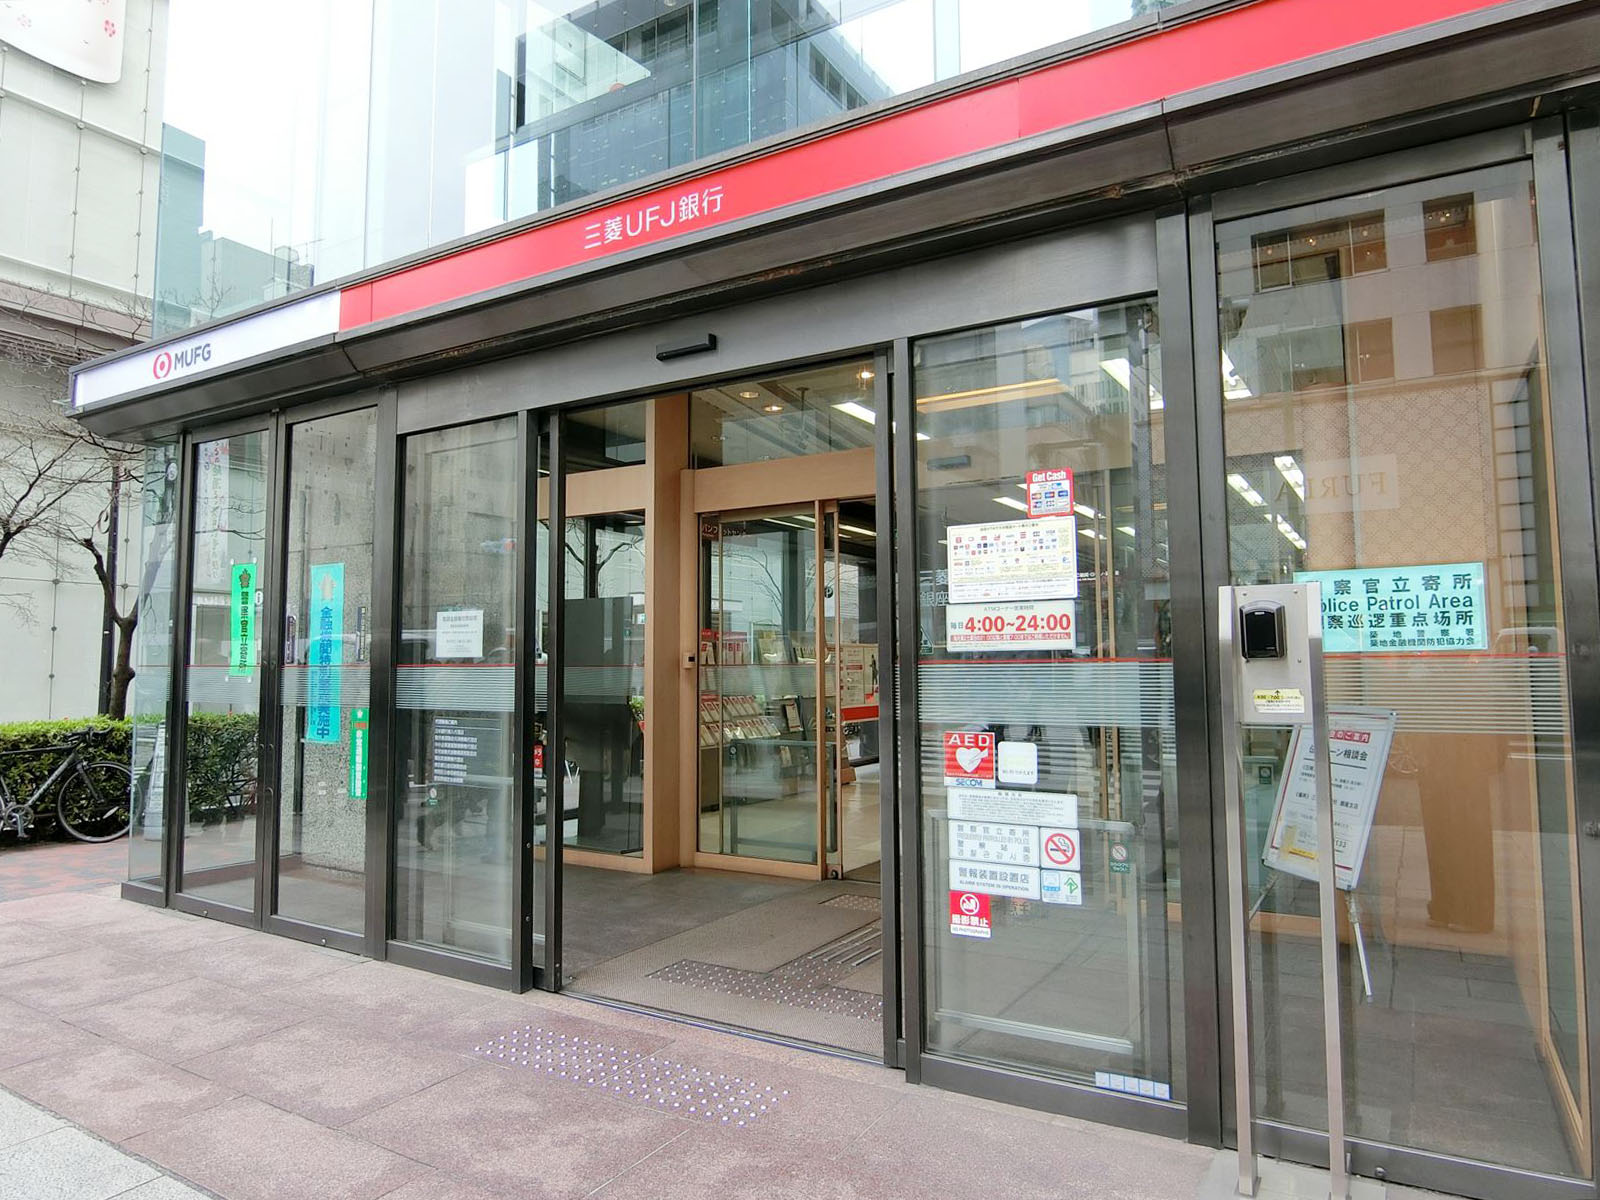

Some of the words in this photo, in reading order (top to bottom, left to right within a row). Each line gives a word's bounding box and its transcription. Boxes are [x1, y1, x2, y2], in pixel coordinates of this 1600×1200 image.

[583, 185, 724, 250] 三菱UFJ銀行
[174, 343, 212, 370] MUFG
[1032, 472, 1046, 482] Get
[1046, 470, 1067, 481] Cash
[1333, 573, 1473, 596] 察官立寄所
[1321, 598, 1359, 613] olice
[1367, 594, 1420, 611] Patrol
[1429, 592, 1474, 609] Area
[1321, 609, 1475, 630] 察巡逻重点场所
[948, 734, 990, 747] AED
[955, 778, 982, 787] SECOM
[952, 913, 989, 928] 撮影禁止
